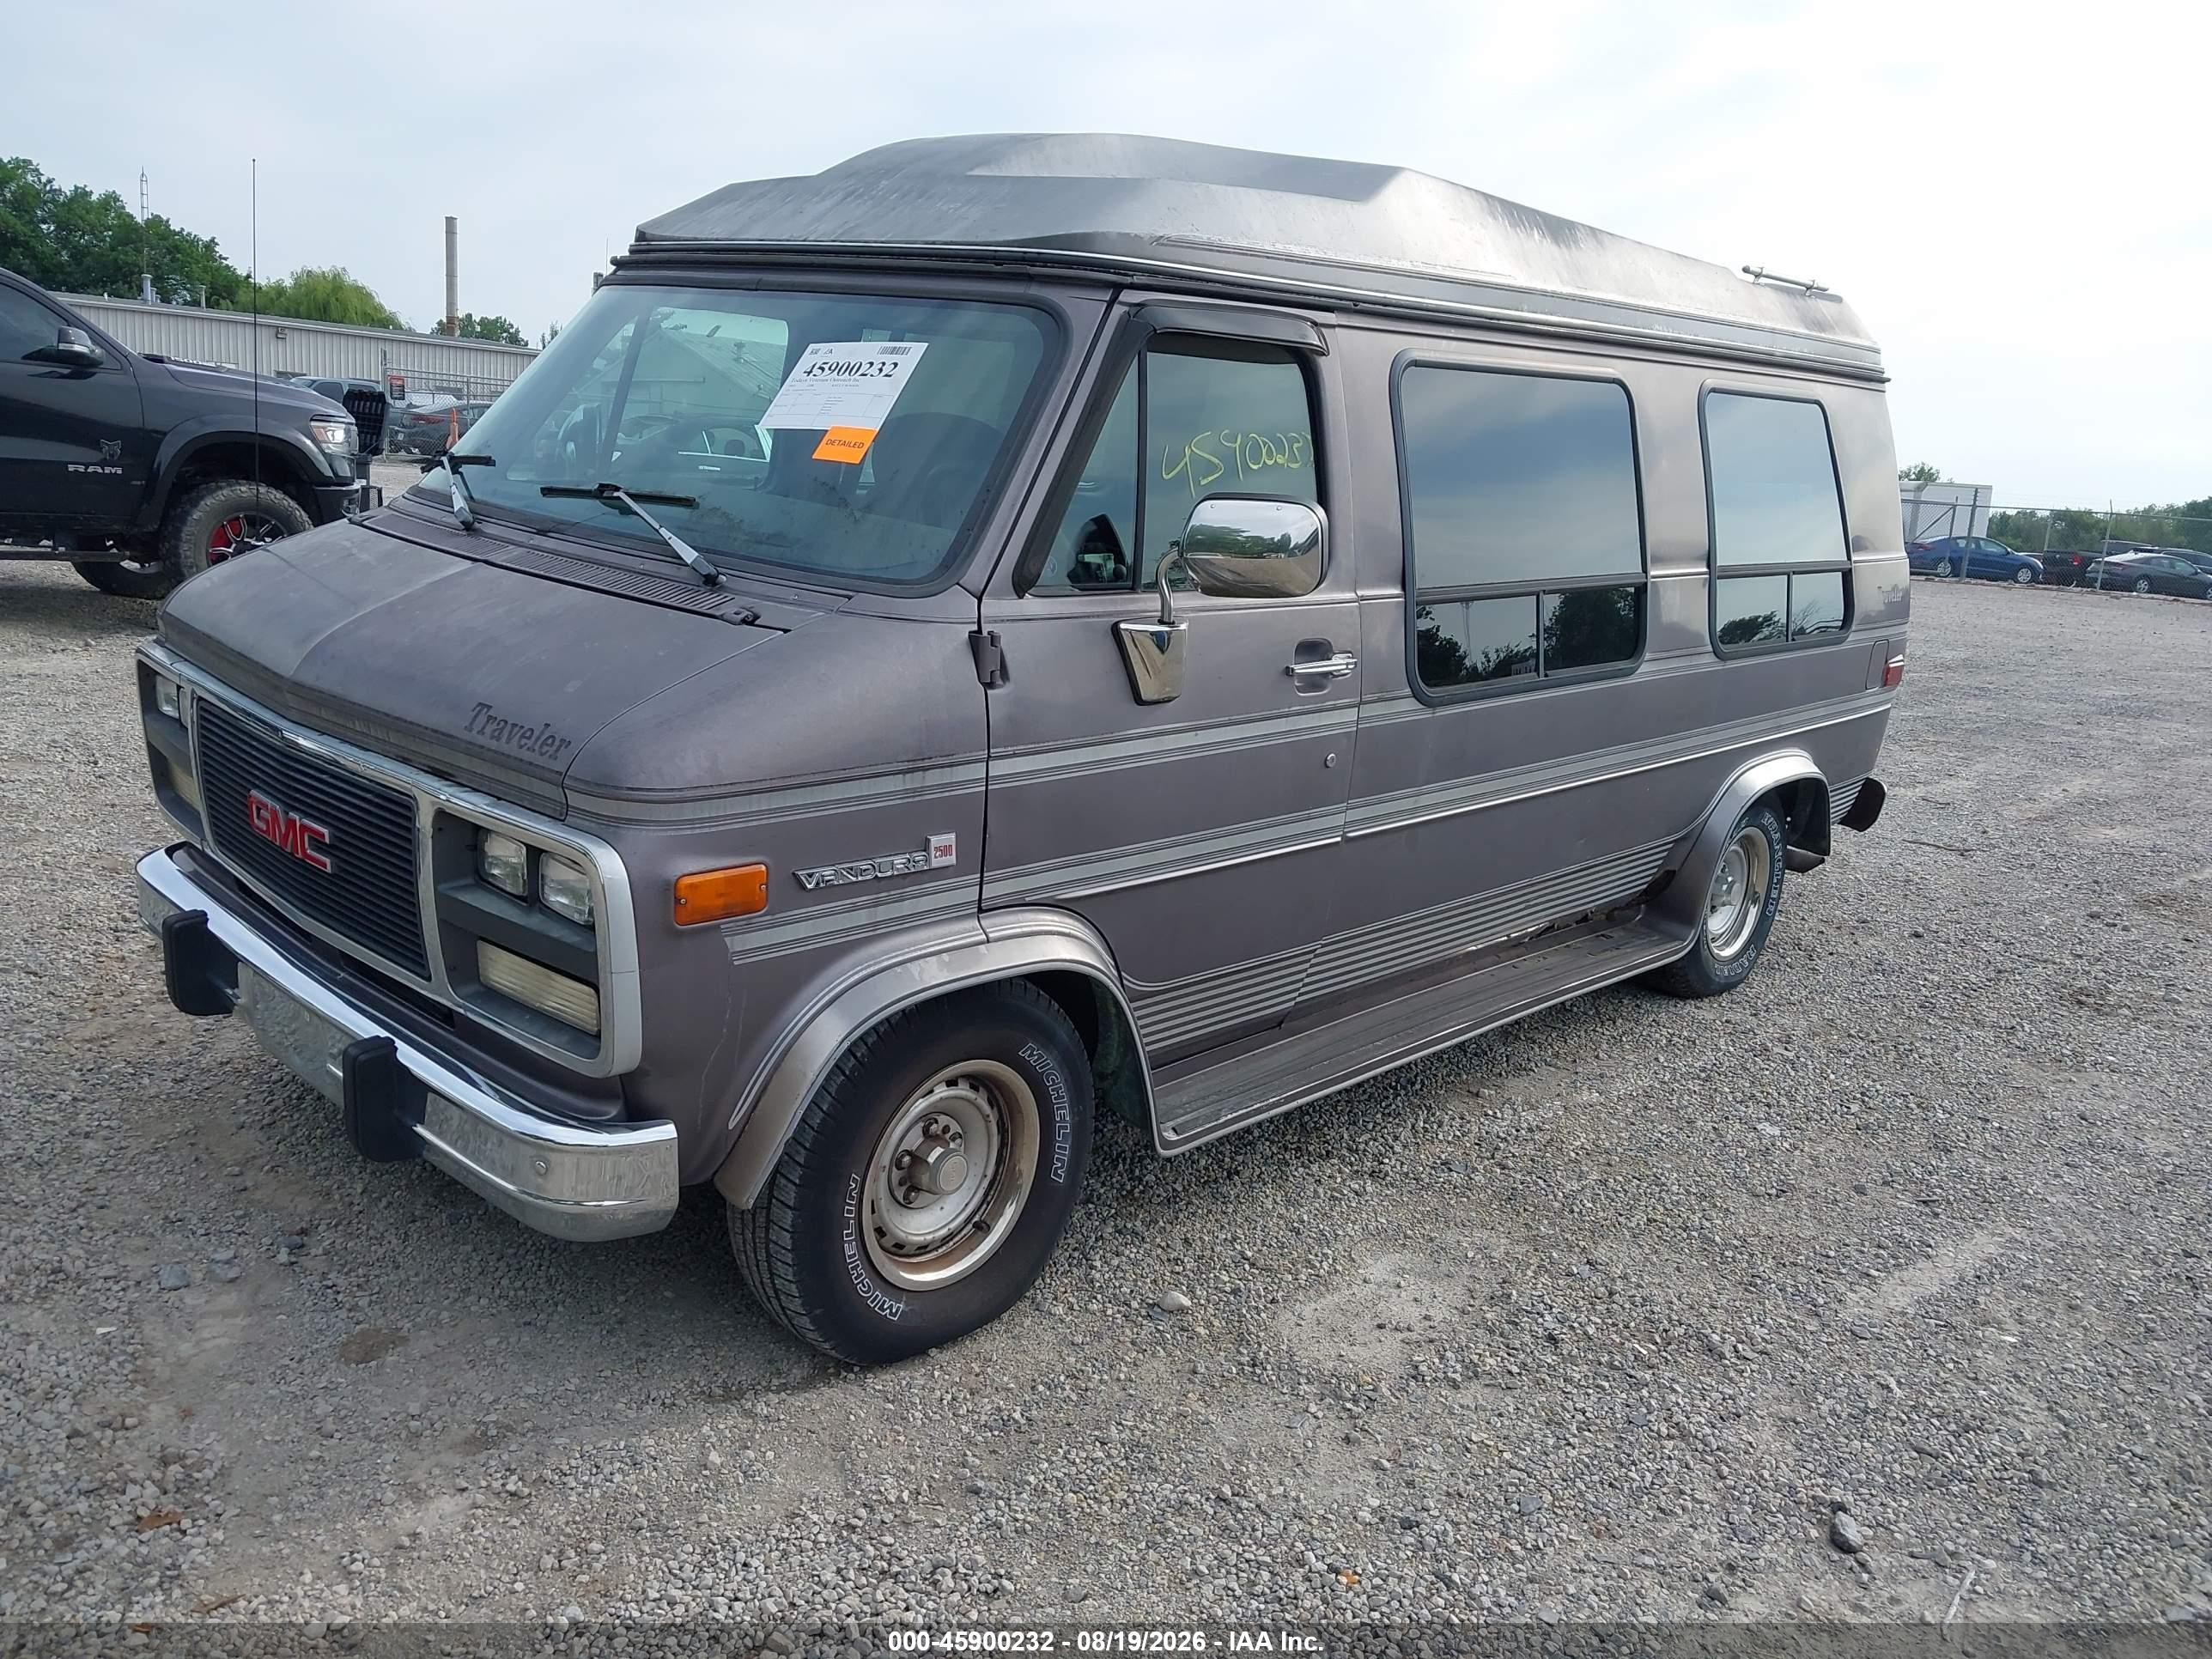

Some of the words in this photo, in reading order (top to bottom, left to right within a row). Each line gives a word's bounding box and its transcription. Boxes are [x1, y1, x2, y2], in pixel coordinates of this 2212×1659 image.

[803, 361, 898, 378] 45900232
[825, 438, 865, 450] DETAILED
[67, 465, 123, 474] RAM
[464, 702, 572, 762] Traveler
[246, 789, 331, 873] GMC
[933, 844, 953, 859] 2500
[793, 850, 928, 891] VANDURA
[1760, 811, 1783, 917] WRANGLER
[1714, 944, 1757, 976] RADIAL
[1018, 1042, 1072, 1183] MICHELIN
[842, 1173, 902, 1321] MICHELIN
